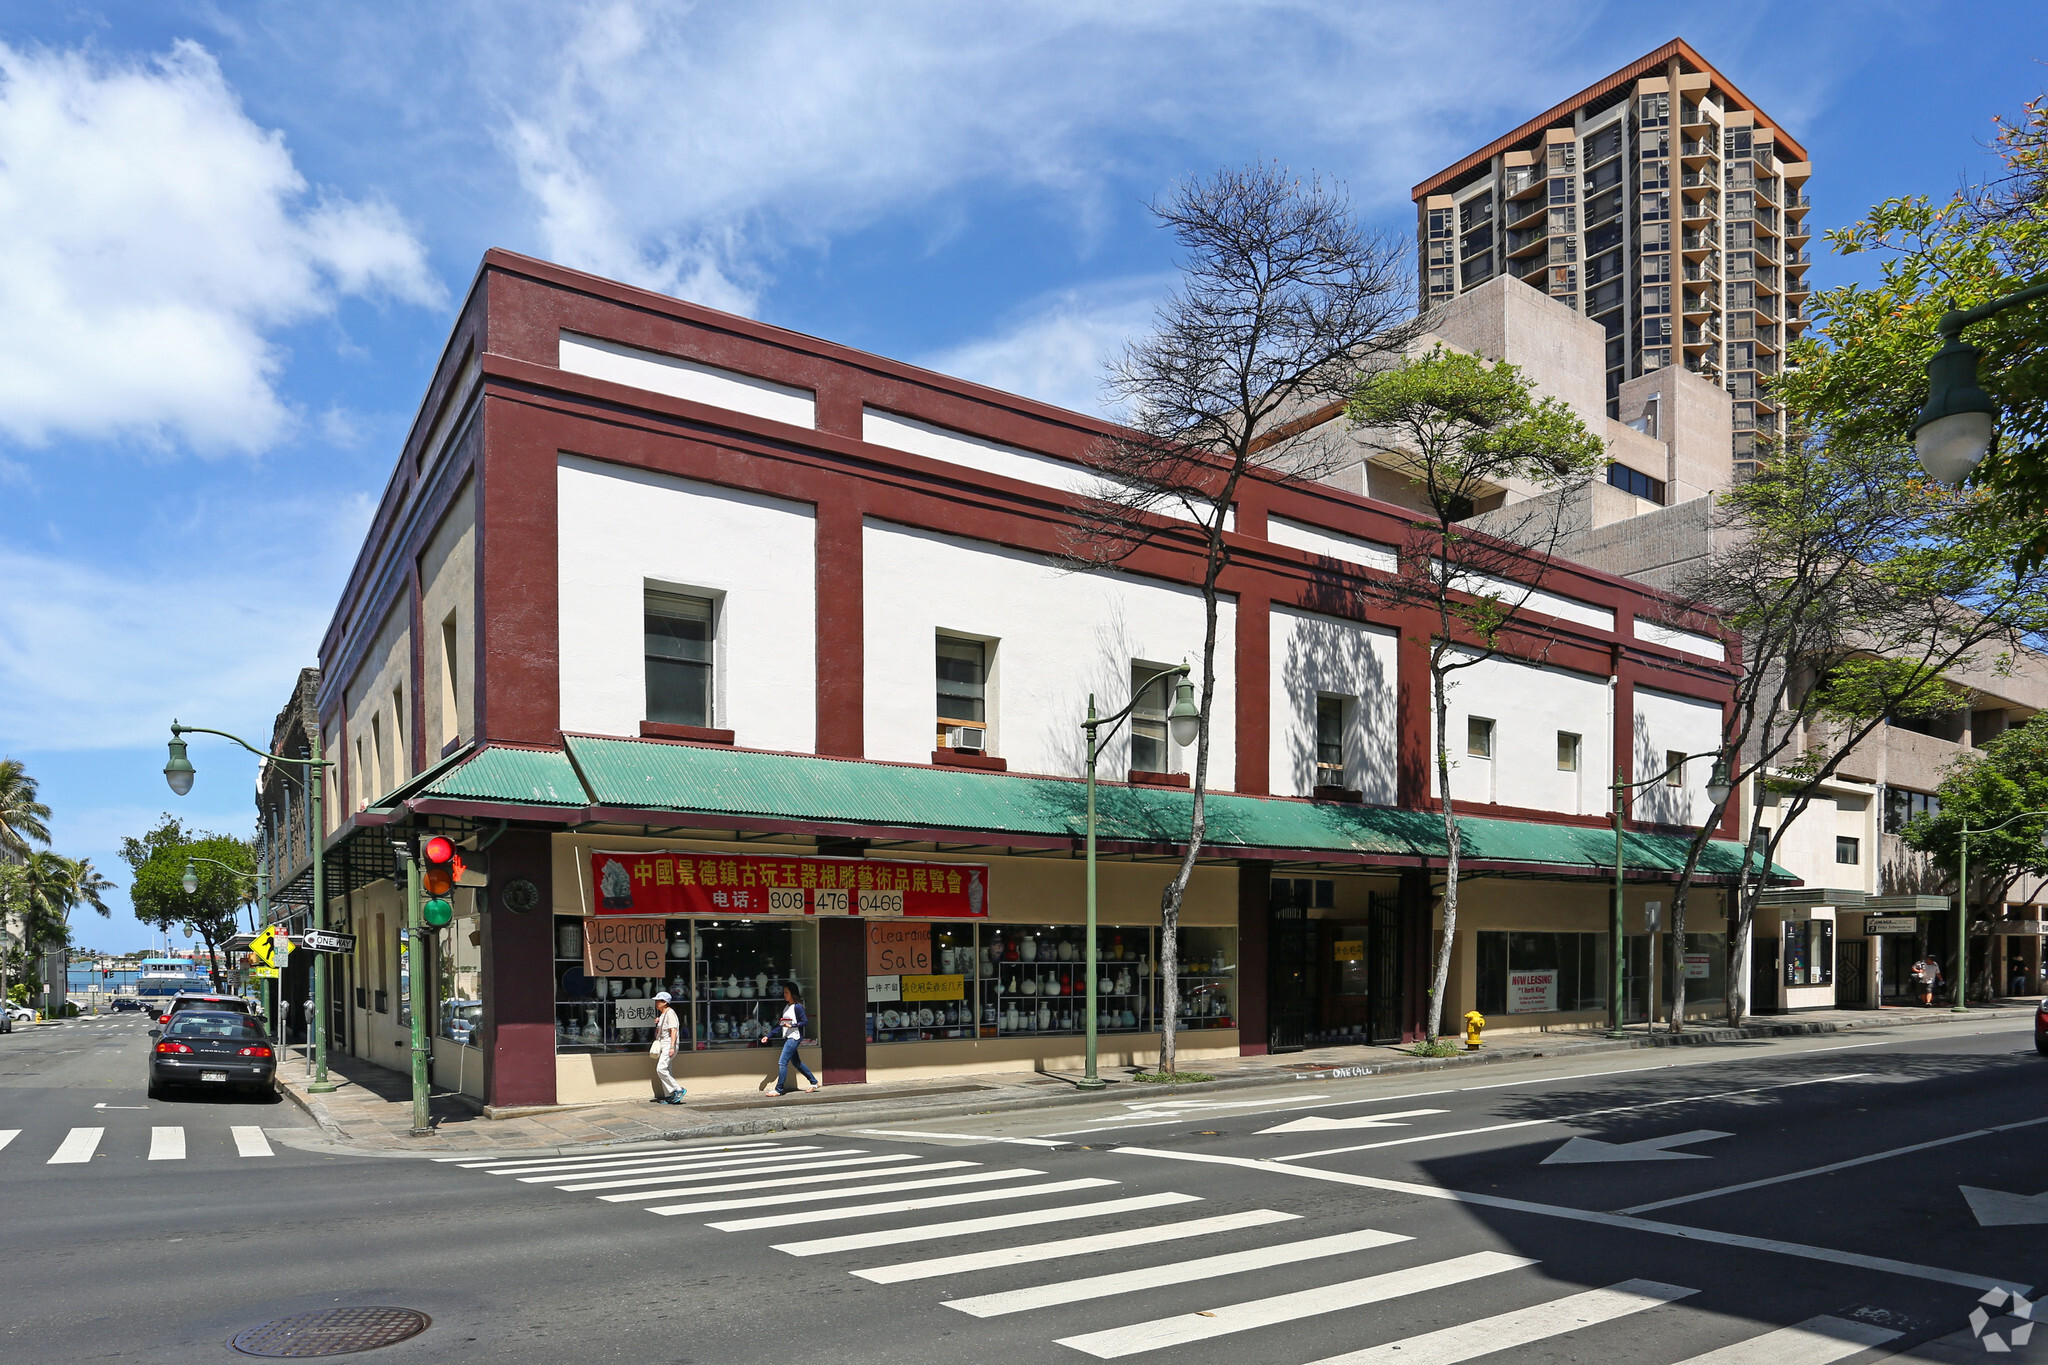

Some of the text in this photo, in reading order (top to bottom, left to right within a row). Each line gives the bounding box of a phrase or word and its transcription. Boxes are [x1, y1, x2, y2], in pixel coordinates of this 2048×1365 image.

[634, 858, 962, 894] 中國景德鎮古玩玉器根雕藝術品展覽會
[316, 936, 352, 949] ONE WAY
[586, 920, 666, 945] Clearance
[595, 946, 660, 973] Sale
[880, 946, 928, 971] Sale
[1512, 974, 1553, 986] NOW LEASING!
